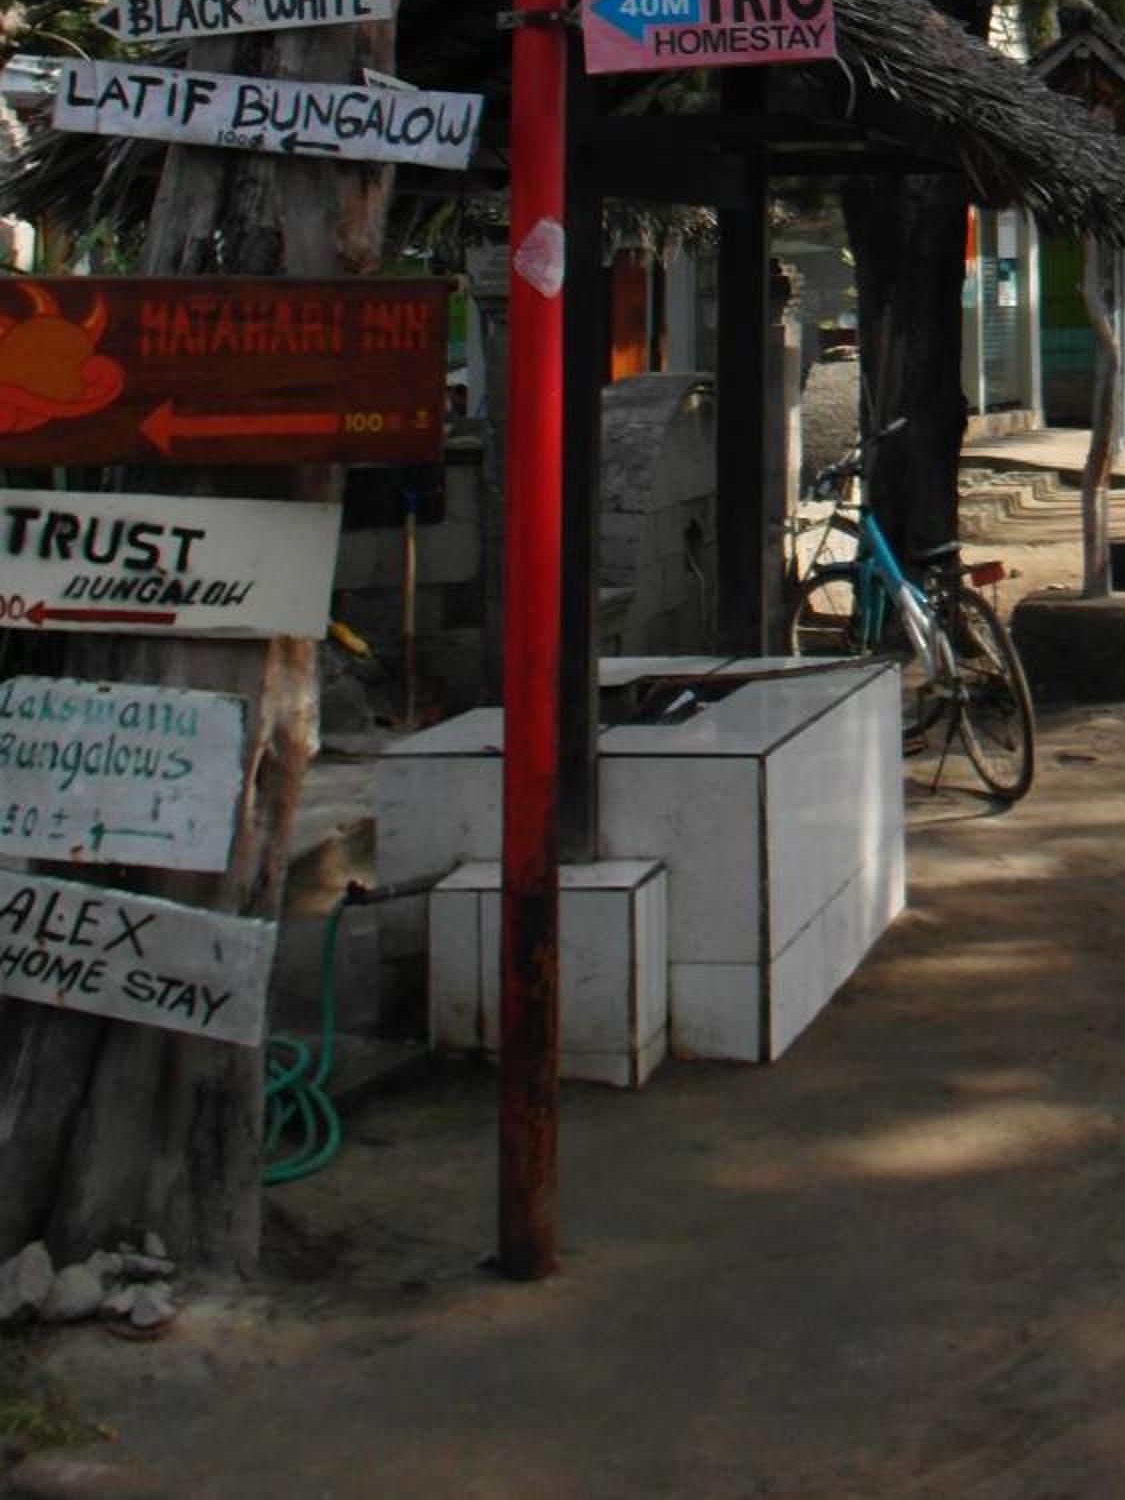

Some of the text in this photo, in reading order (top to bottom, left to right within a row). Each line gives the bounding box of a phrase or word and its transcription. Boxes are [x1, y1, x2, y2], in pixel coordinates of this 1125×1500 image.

[653, 23, 827, 56] HOMESTAY
[231, 84, 473, 147] BUNGALOW
[358, 298, 430, 350] INN
[344, 413, 384, 433] 100
[6, 506, 206, 574] TRUST
[0, 887, 155, 958] ALEX
[0, 945, 232, 1026] HOME STAY
